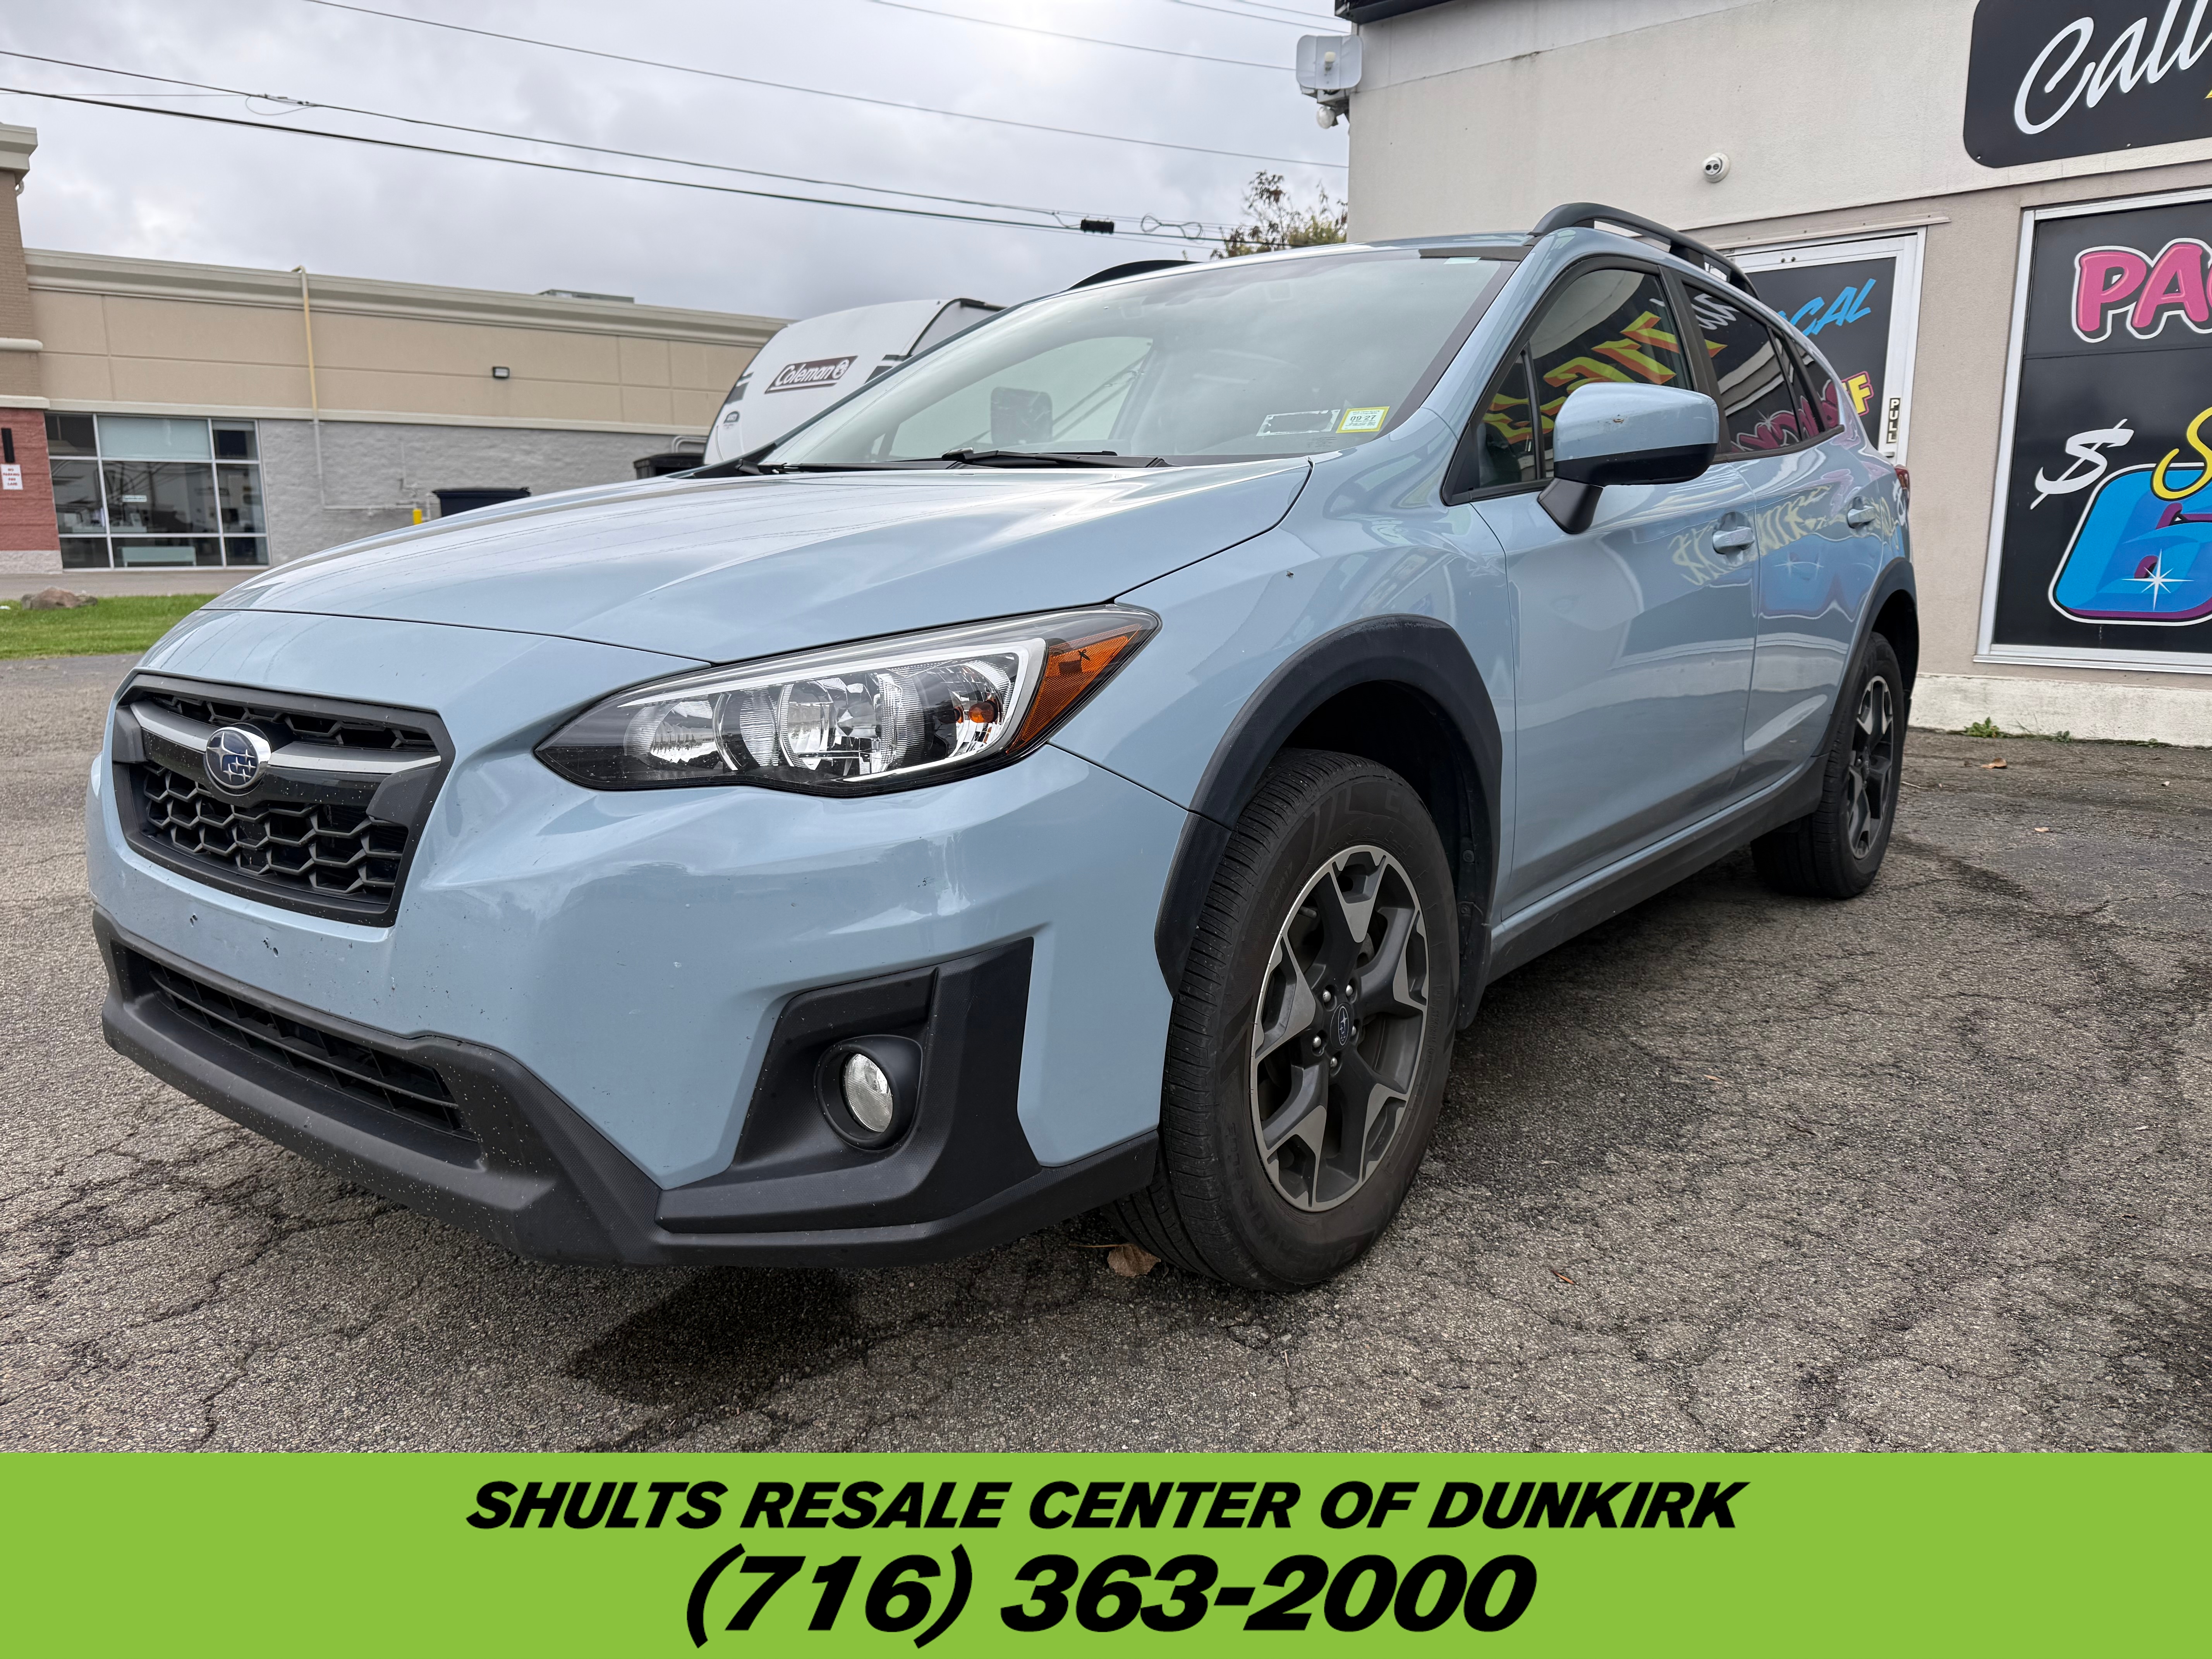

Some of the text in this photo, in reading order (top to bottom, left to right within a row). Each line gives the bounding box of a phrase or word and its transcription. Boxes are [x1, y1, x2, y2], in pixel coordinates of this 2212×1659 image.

[2014, 0, 2212, 134] Call
[1778, 278, 1876, 336] CAL
[2073, 239, 2212, 342] PA
[775, 363, 835, 386] Coleman
[1841, 371, 1874, 417] F
[1887, 399, 1899, 442] PULL
